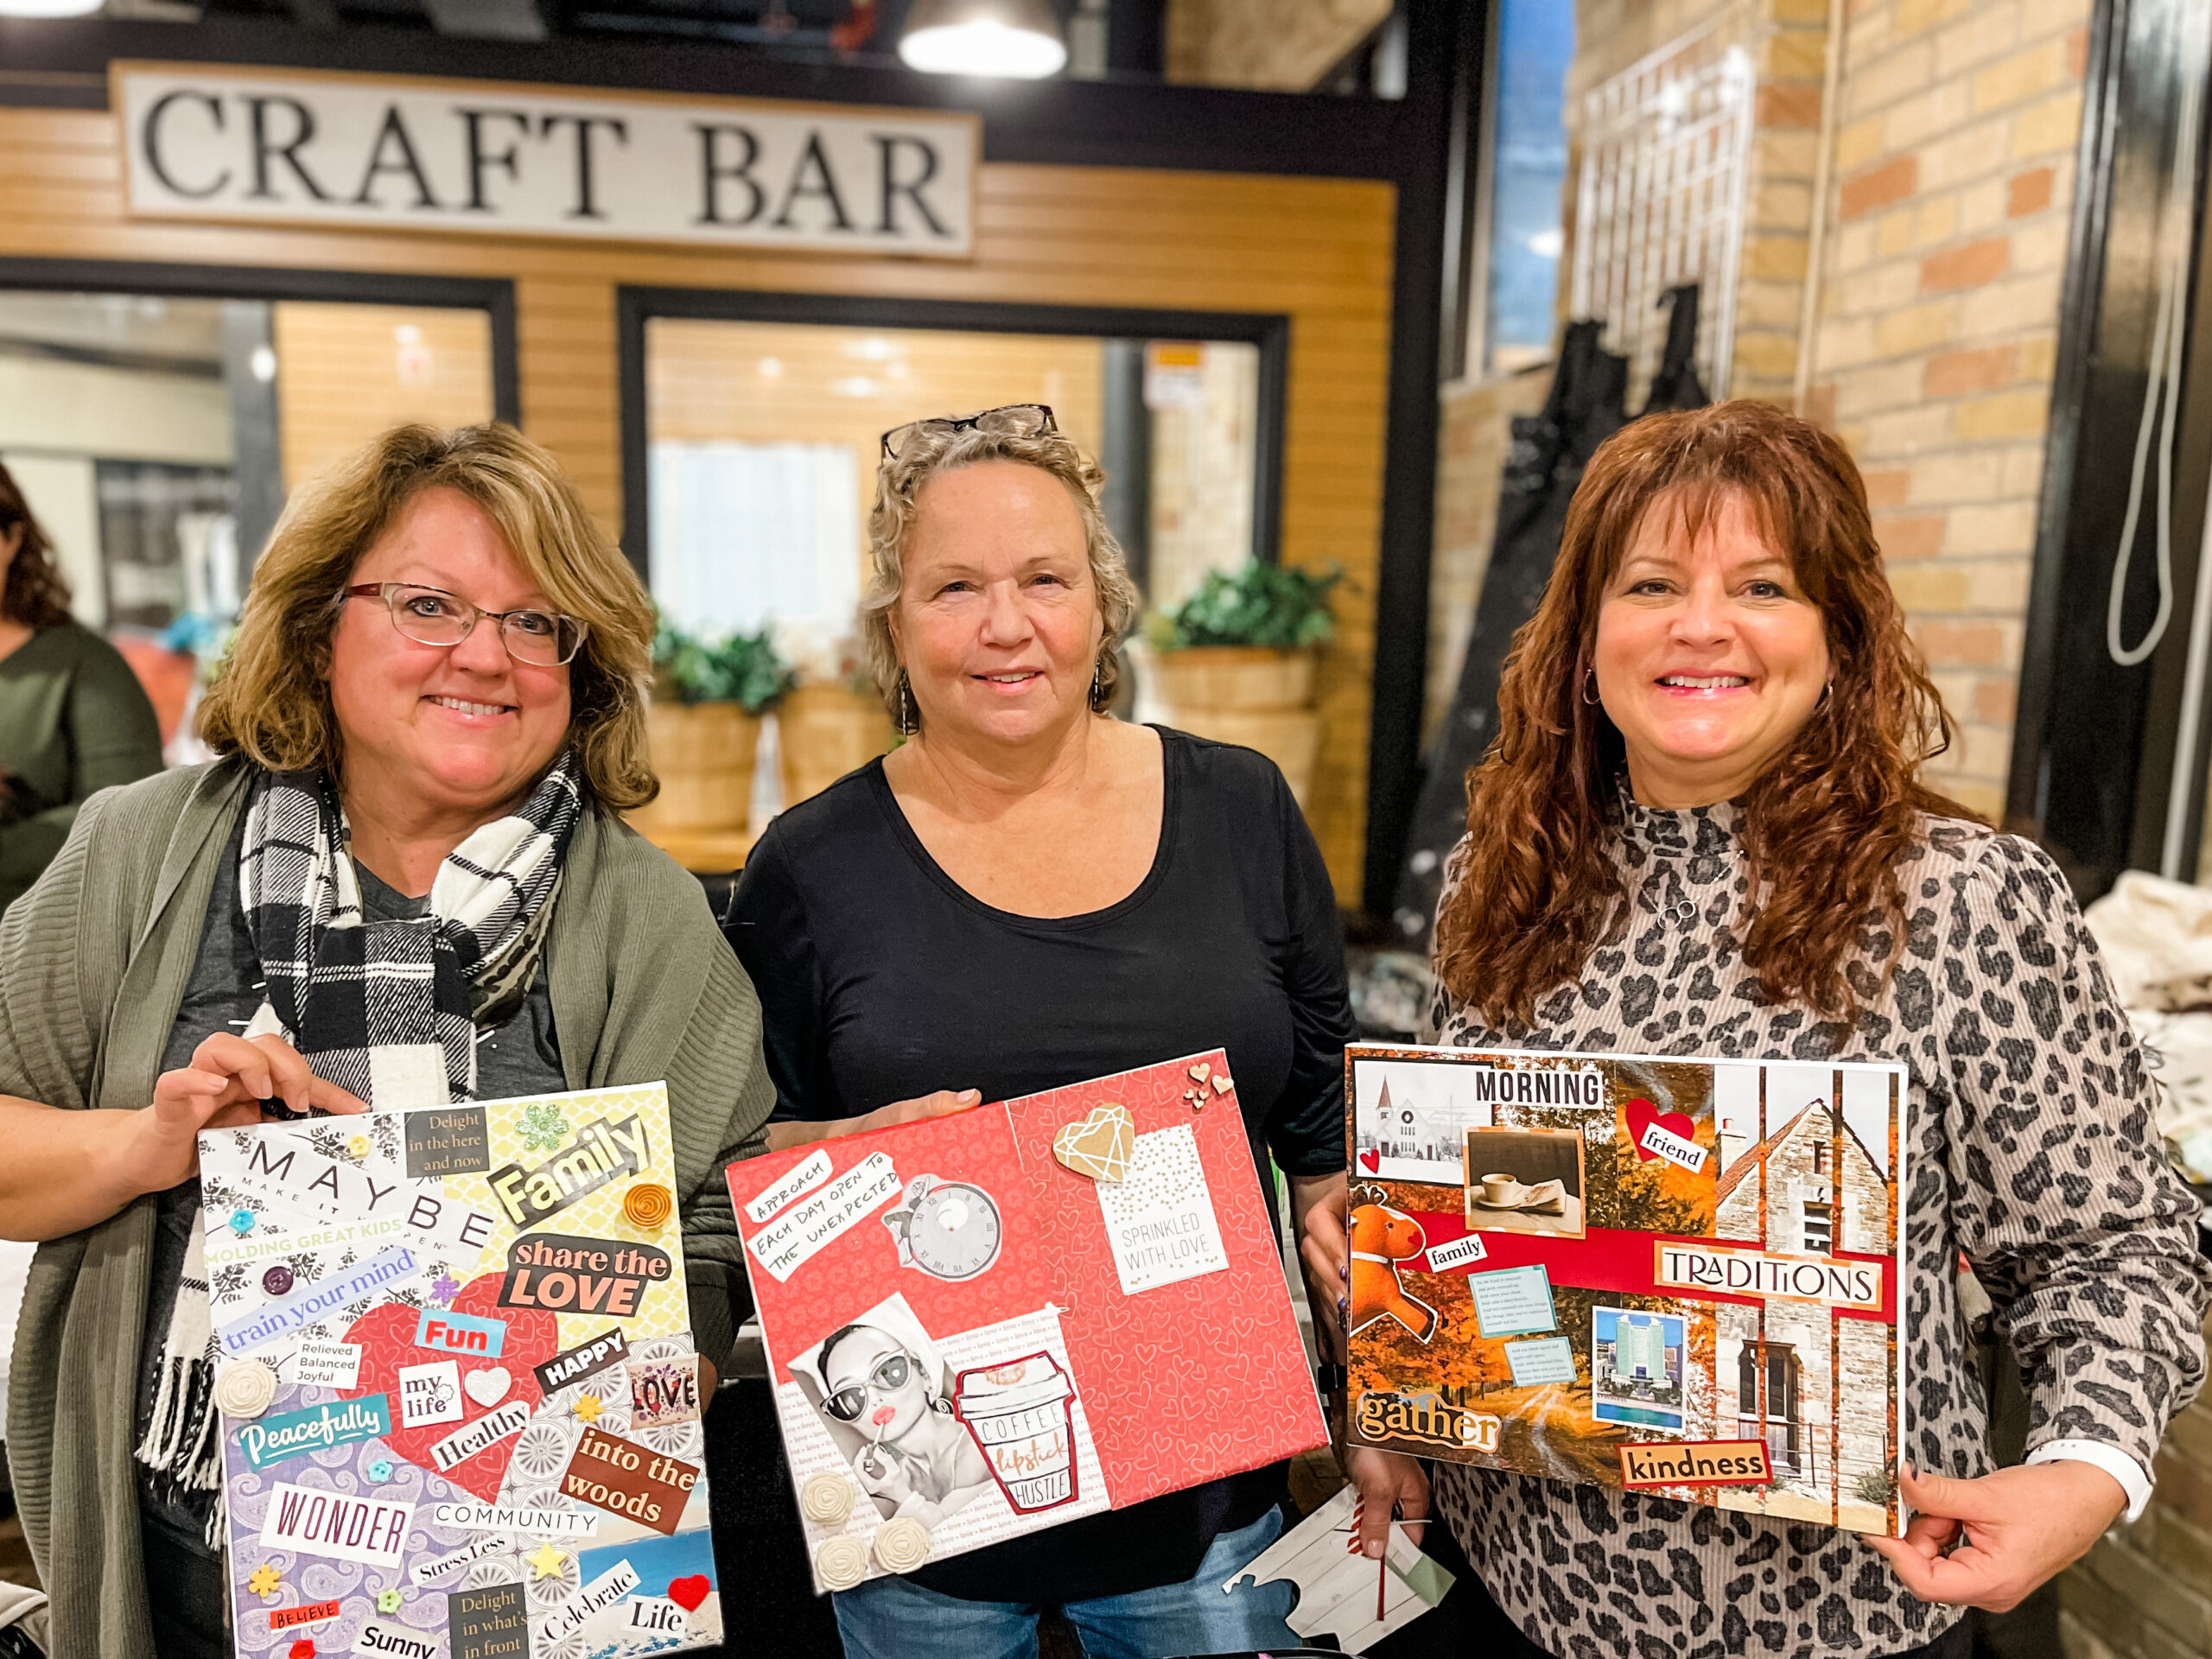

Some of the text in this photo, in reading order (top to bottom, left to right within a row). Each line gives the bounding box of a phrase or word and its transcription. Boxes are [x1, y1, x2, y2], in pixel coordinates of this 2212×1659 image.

[141, 87, 954, 238] CRAFT BAR
[1476, 1071, 1599, 1105] MORNING
[429, 1113, 479, 1131] Delight
[410, 1135, 480, 1152] in the here
[1646, 1132, 1700, 1166] friend
[424, 1156, 482, 1171] and now
[493, 1116, 649, 1224] Family
[242, 1177, 300, 1202] MAKE
[249, 1141, 493, 1249] MAYBE
[757, 1162, 823, 1218] APPROACH
[757, 1224, 792, 1255] EACH
[796, 1199, 826, 1224] DAY
[830, 1172, 861, 1200] OPEN
[1122, 1212, 1199, 1247] SPRINKLED
[204, 1219, 402, 1265] MOLDING GREAT KIDS
[516, 1240, 668, 1277] share the
[768, 1243, 798, 1271] THE
[1124, 1234, 1210, 1271] WITH LOVE
[1431, 1239, 1480, 1265] family
[509, 1269, 639, 1314] LOVE
[1664, 1252, 1872, 1300] TRADITIONS
[226, 1249, 415, 1351] train your mind
[302, 1344, 353, 1356] Relieved
[425, 1320, 487, 1351] Fun
[297, 1370, 334, 1382] Joyful
[300, 1357, 355, 1370] Balanced
[544, 1332, 623, 1386] HAPPY
[405, 1376, 442, 1395] my
[632, 1376, 696, 1411] LOVE
[408, 1397, 446, 1418] life
[982, 1405, 1061, 1440] COFFEE
[1361, 1396, 1498, 1446] gather
[240, 1403, 380, 1465] Peacefully
[438, 1405, 526, 1466] Healthy
[580, 1430, 695, 1491] into the
[995, 1433, 1067, 1477] lipstick
[1627, 1449, 1763, 1480] kindness
[567, 1474, 661, 1522] woods
[1015, 1473, 1067, 1505] HUSTLE
[277, 1491, 405, 1554] WONDER
[435, 1505, 597, 1531] COMMUNITY
[420, 1537, 505, 1580] Stress Less
[277, 1604, 335, 1629] BELIEVE
[461, 1591, 516, 1612] Delight
[543, 1571, 632, 1641] Celebrate
[631, 1602, 683, 1632] Life
[463, 1611, 527, 1636] in what's
[360, 1626, 435, 1659] Sunny
[465, 1638, 520, 1659] in front
